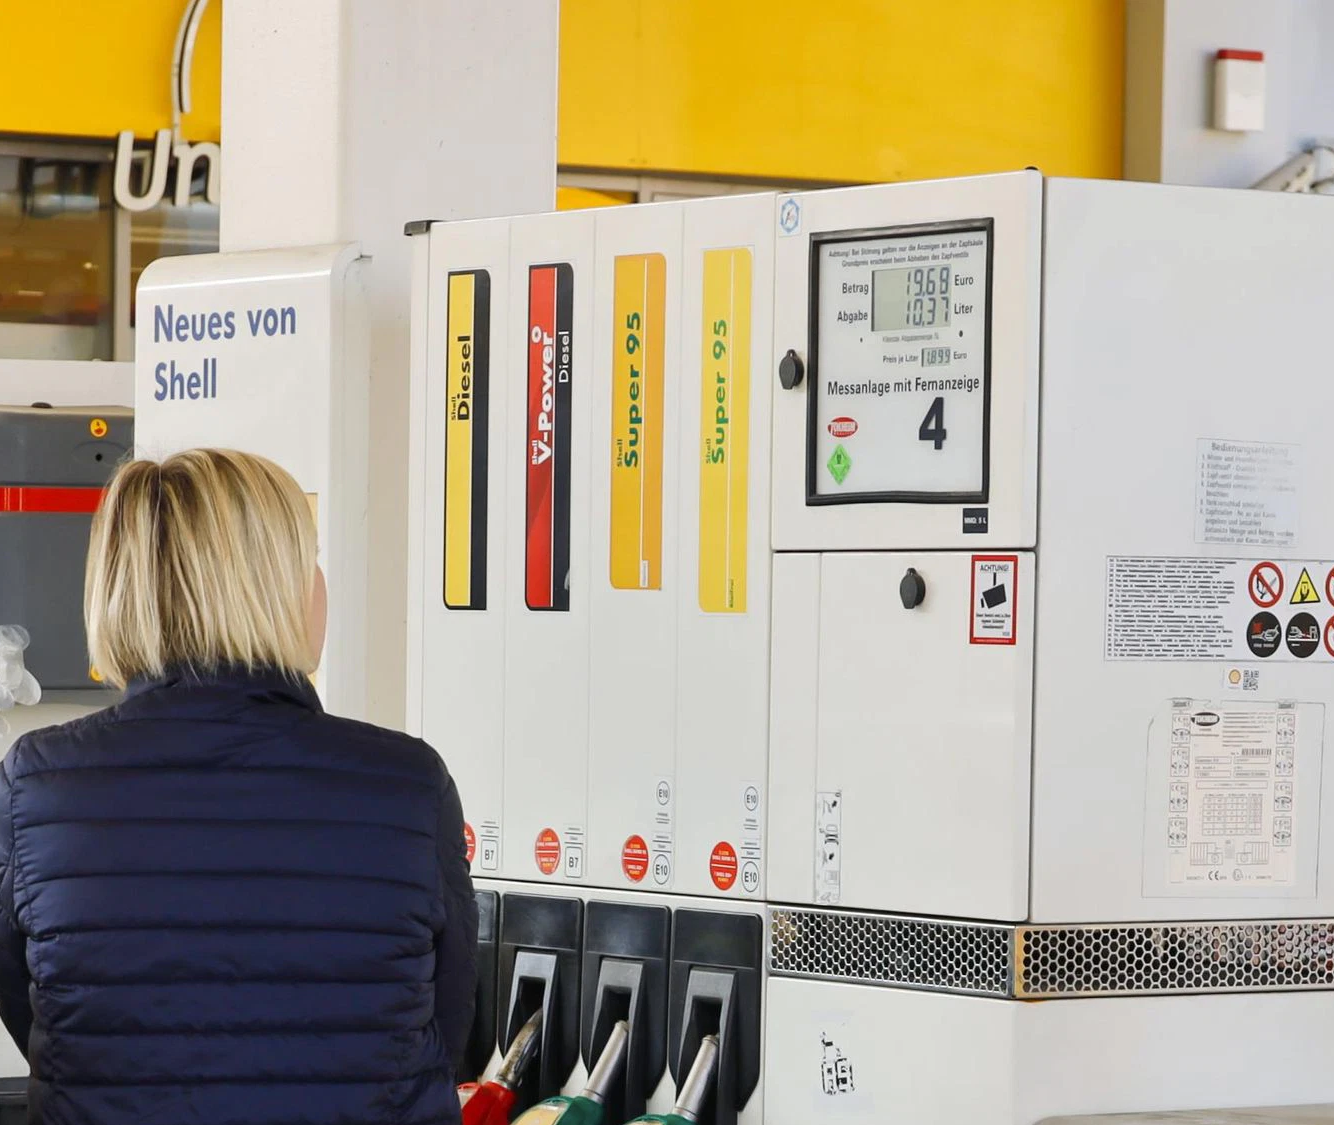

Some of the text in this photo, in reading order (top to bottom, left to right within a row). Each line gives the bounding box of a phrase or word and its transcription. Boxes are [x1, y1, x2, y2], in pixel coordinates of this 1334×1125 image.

[842, 267, 974, 297] Betrag 19,68 Euro
[154, 304, 296, 344] Neues von
[837, 297, 973, 327] Abgabe 10,37 Liter
[559, 331, 570, 383] Diesel
[883, 354, 897, 363] Preis
[905, 353, 919, 363] Liter
[953, 351, 967, 361] Euro
[154, 358, 218, 401] Shell
[457, 335, 471, 421] Diesel
[625, 312, 642, 468] Super 95
[712, 319, 729, 464] Super 95
[827, 375, 980, 397] Messanlage mit Fernanzeige
[538, 332, 554, 465] V-Power
[919, 397, 947, 450] 4
[659, 788, 668, 799] E10
[747, 793, 756, 804] E10
[484, 849, 494, 861] B7
[568, 856, 578, 868] B7
[655, 865, 668, 876] E10
[744, 872, 757, 883] E10
